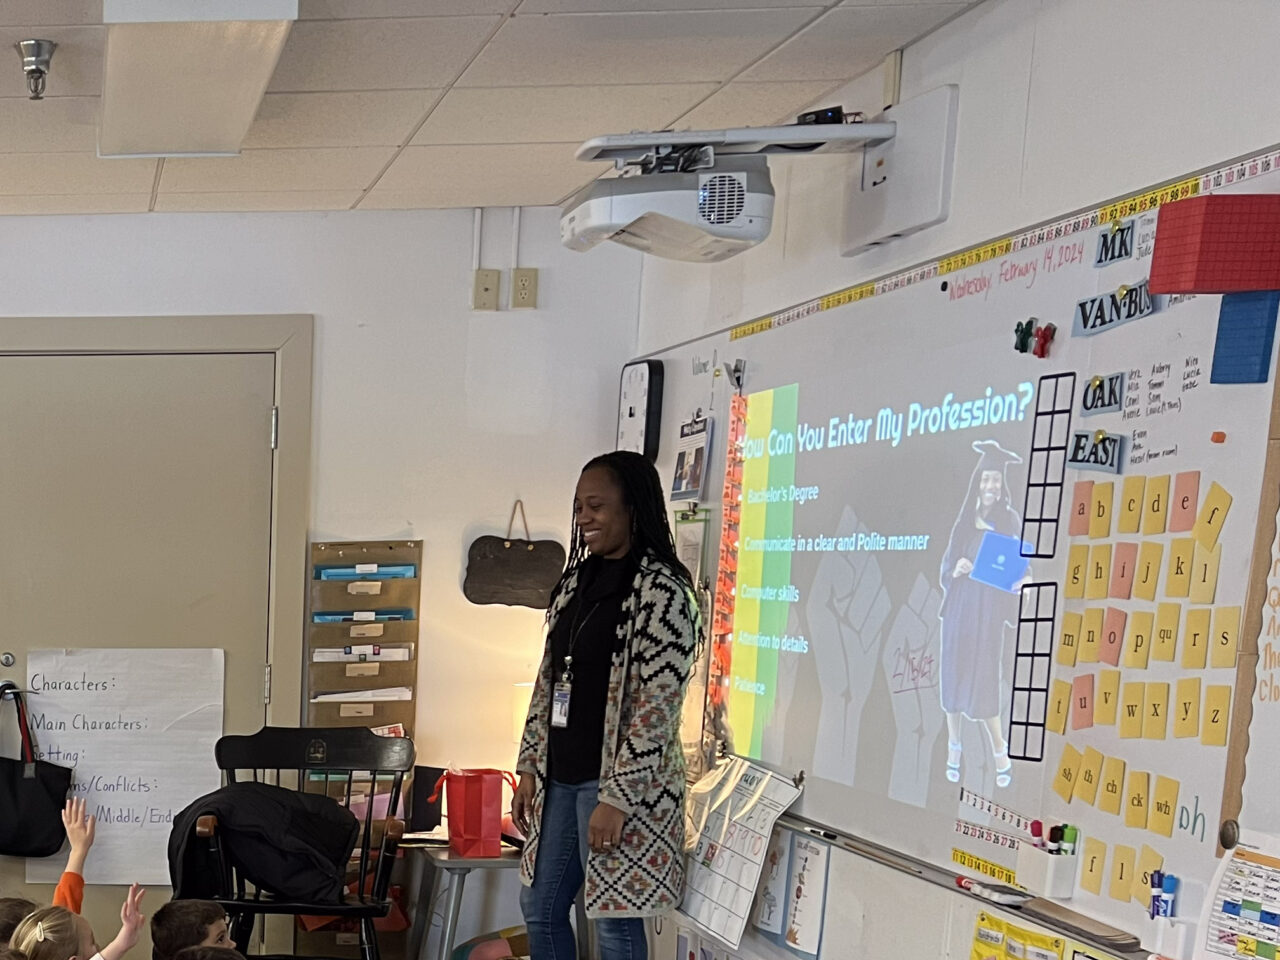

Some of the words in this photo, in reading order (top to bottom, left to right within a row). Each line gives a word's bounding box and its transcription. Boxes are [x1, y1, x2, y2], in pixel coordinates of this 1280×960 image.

[1097, 226, 1130, 263] MK
[999, 257, 1038, 288] February
[1058, 240, 1084, 268] 2024
[1083, 376, 1119, 410] OAK
[797, 423, 824, 452] You
[828, 414, 872, 448] Enter
[875, 407, 903, 447] My
[907, 382, 1034, 435] Profession?
[1069, 434, 1118, 467] EAST
[788, 485, 819, 504] Degree
[1077, 501, 1085, 515] a
[1097, 500, 1105, 517] b
[1128, 497, 1135, 512] c
[1152, 494, 1160, 512] d
[1181, 495, 1189, 510] e
[1207, 507, 1219, 524] f
[798, 535, 806, 550] in
[807, 538, 812, 550] a
[815, 534, 836, 550] clear
[837, 536, 855, 550] and
[857, 533, 886, 550] Polite
[888, 534, 929, 550] manner
[1072, 564, 1080, 584] g
[1095, 562, 1103, 579] h
[1142, 563, 1150, 583] j
[1175, 556, 1184, 575] k
[778, 585, 799, 602] skills
[772, 634, 779, 649] to
[781, 634, 808, 653] details
[1063, 632, 1074, 646] m
[1087, 629, 1095, 642] n
[1108, 630, 1116, 643] o
[1134, 634, 1143, 652] p
[1159, 627, 1172, 643] qu
[1192, 631, 1200, 647] r
[1221, 631, 1229, 646] s
[30, 673, 117, 692] Characters:
[1056, 699, 1062, 714] t
[1079, 697, 1087, 709] u
[1103, 691, 1111, 704] v
[1127, 704, 1137, 718] w
[1152, 703, 1160, 717] x
[1183, 701, 1191, 721] y
[1211, 709, 1220, 724] z
[30, 714, 66, 731] Main
[72, 713, 148, 731] Characters:
[36, 745, 85, 768] etting:
[1062, 767, 1072, 783] sh
[1083, 768, 1093, 784] th
[1107, 780, 1117, 794] ch
[1131, 793, 1143, 807] ck
[1156, 800, 1170, 816] wh
[1089, 857, 1095, 872] f
